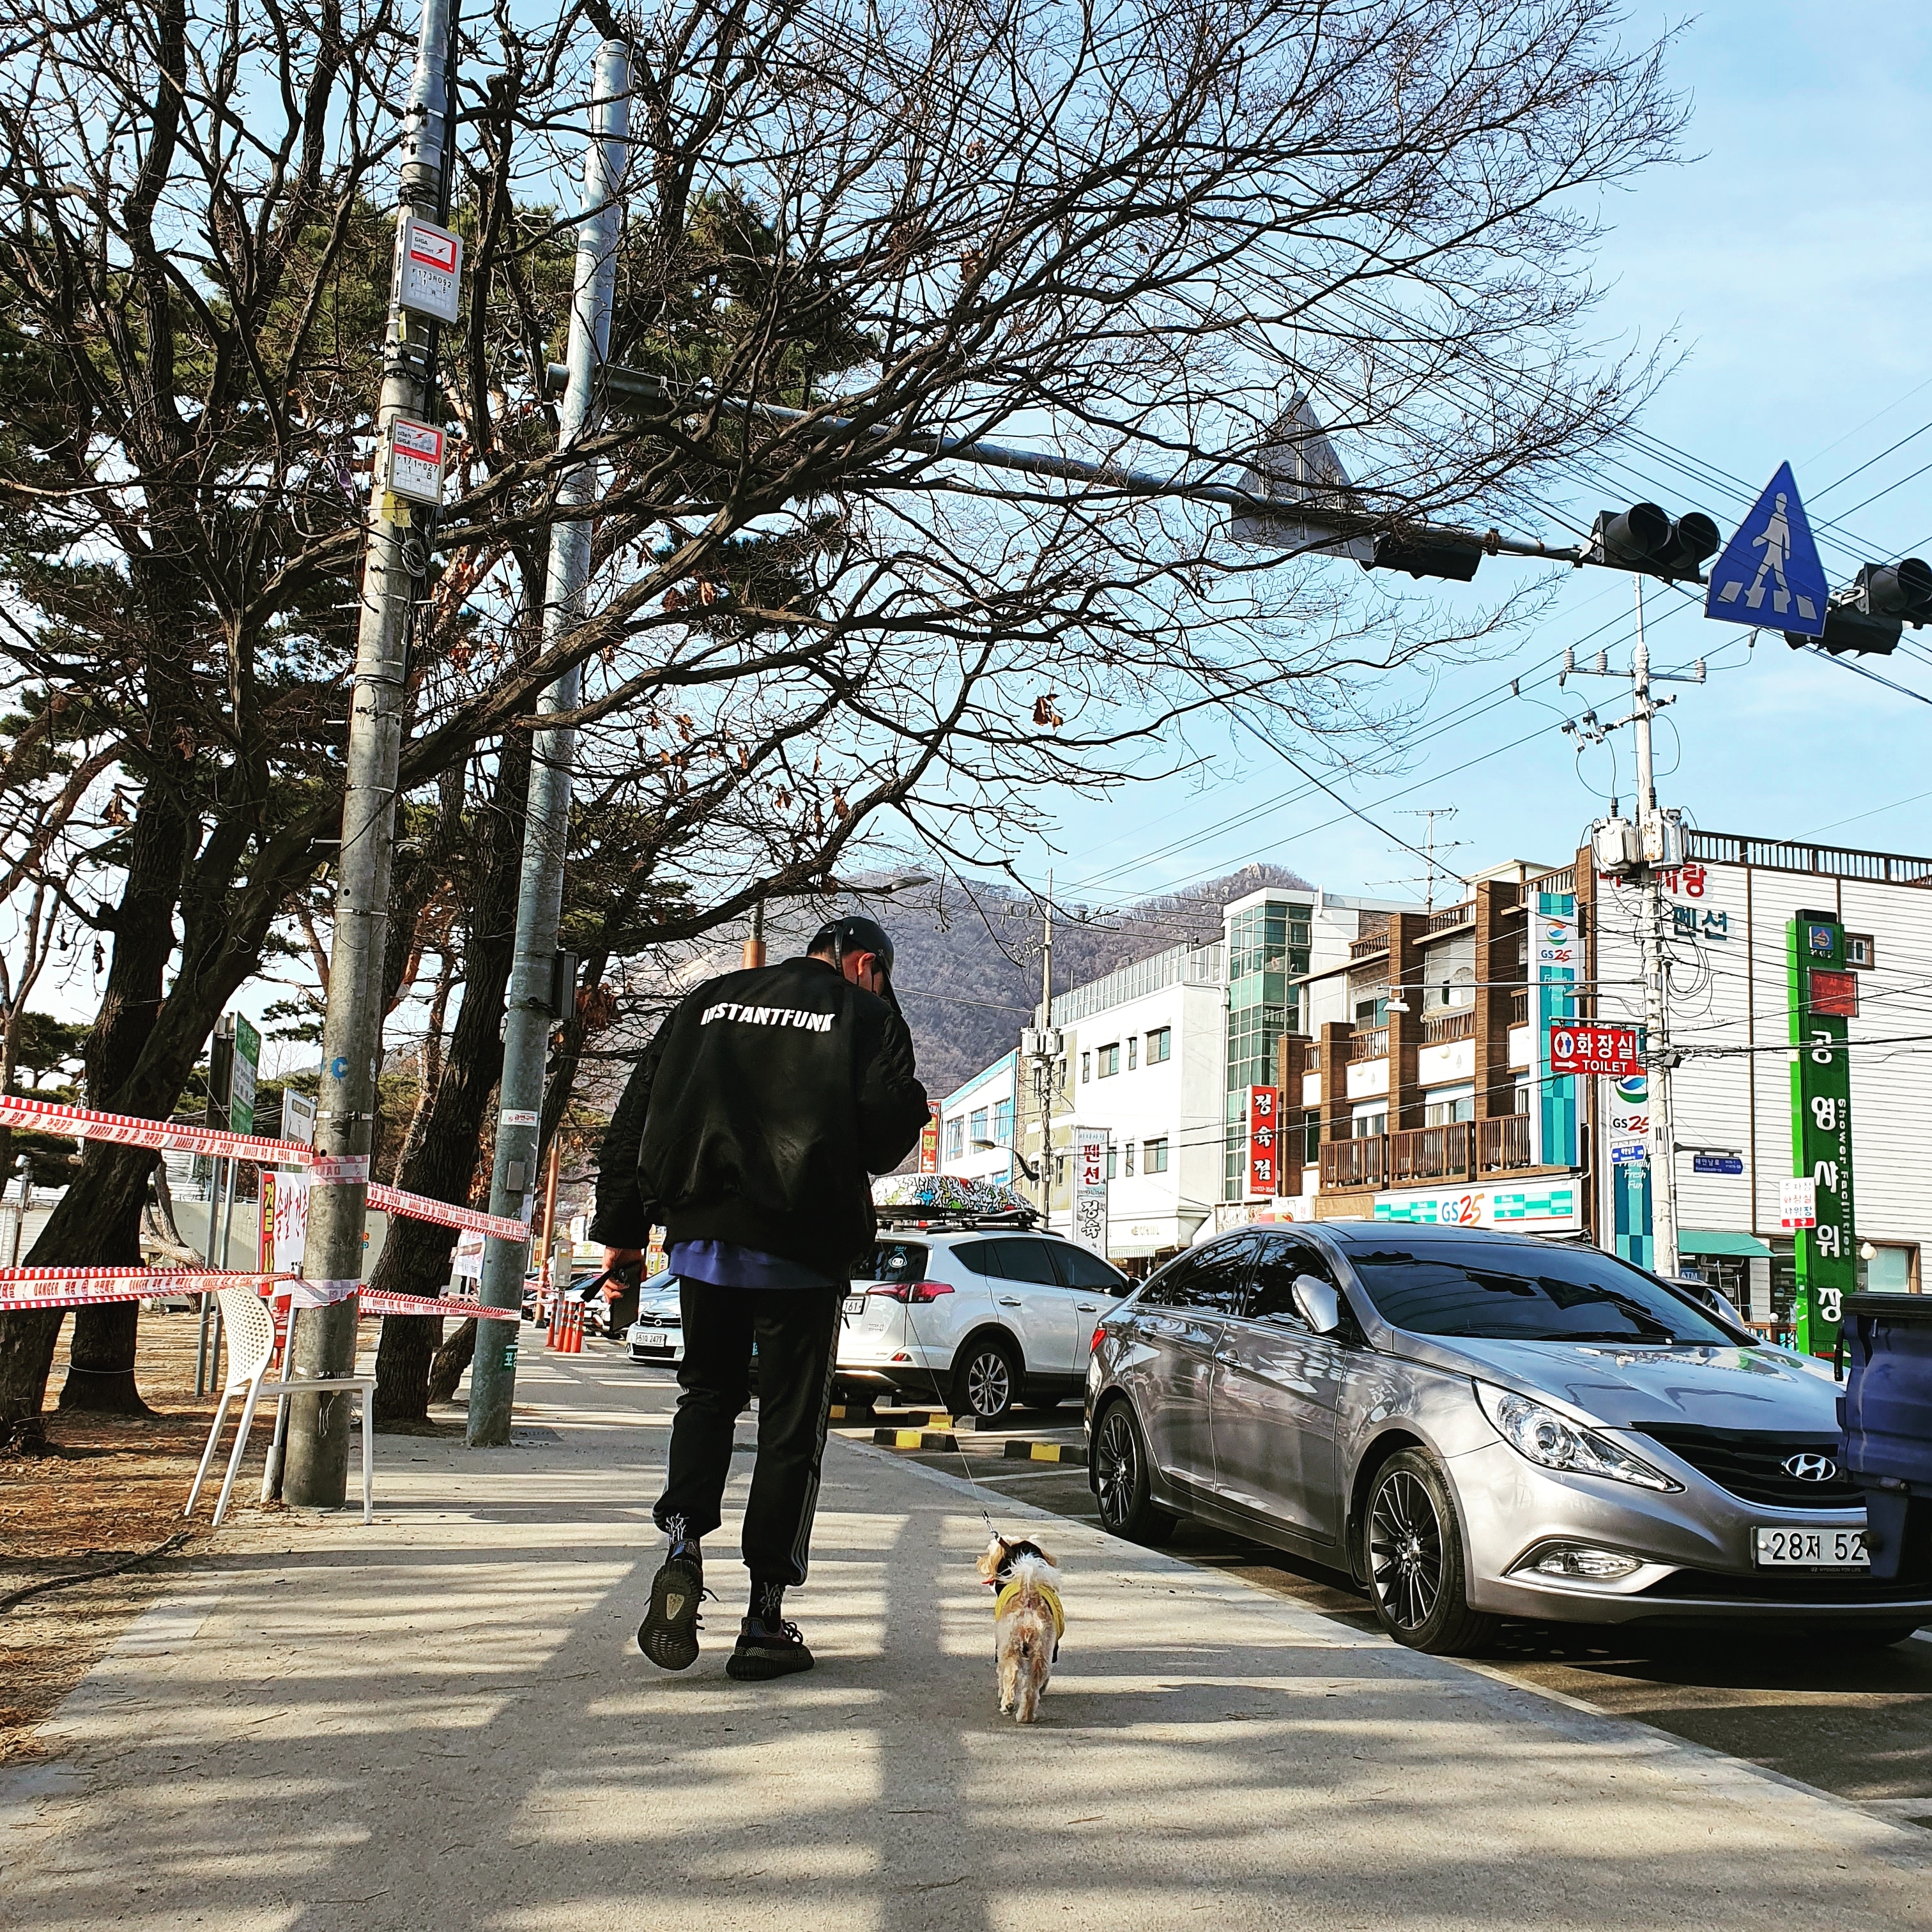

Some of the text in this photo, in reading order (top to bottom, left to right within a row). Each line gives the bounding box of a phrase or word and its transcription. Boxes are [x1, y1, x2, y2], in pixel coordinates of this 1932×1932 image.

[415, 237, 428, 245] GIGA
[414, 243, 434, 254] internet
[1673, 907, 1728, 941] 펜션
[1541, 949, 1572, 962] GS25
[1576, 1032, 1633, 1059] 화장실
[1582, 1059, 1628, 1073] TOILET
[1837, 1098, 1848, 1164] Shower
[1083, 1144, 1100, 1184] 펜션
[1623, 1169, 1646, 1179] Fresh
[1627, 1180, 1643, 1190] Fun
[1782, 1193, 1813, 1204] 화장실
[1441, 1193, 1485, 1225] GS25
[1783, 1206, 1813, 1216] 샤워장
[1681, 1271, 1698, 1280] ATM
[34, 1282, 59, 1296] DANGER
[65, 1281, 77, 1295] 위험
[95, 1280, 116, 1293] 안전제일
[1772, 1532, 1820, 1560] 28저
